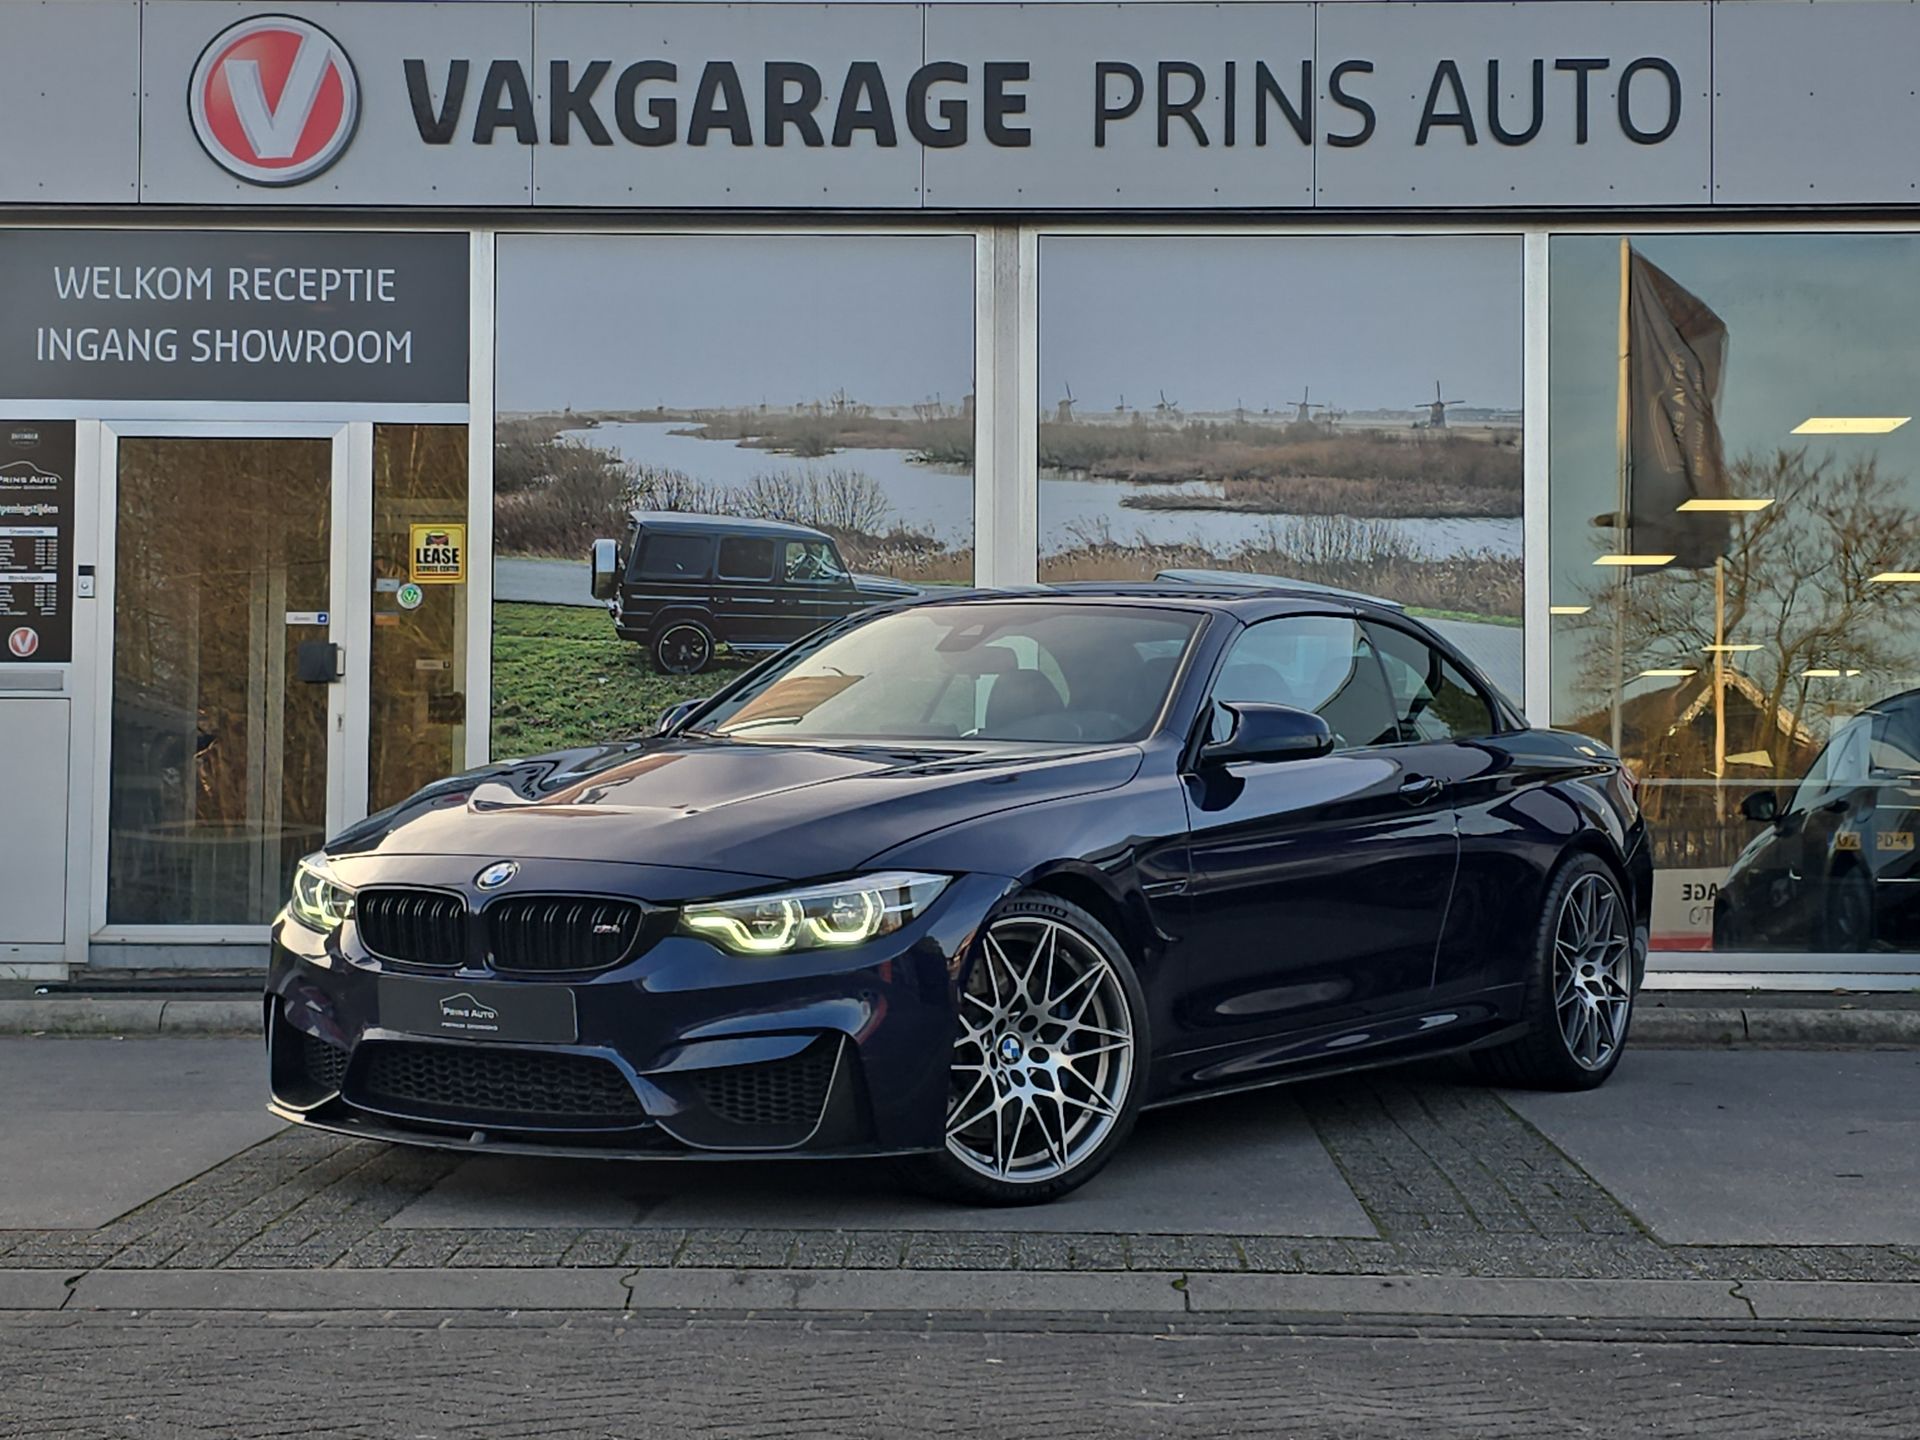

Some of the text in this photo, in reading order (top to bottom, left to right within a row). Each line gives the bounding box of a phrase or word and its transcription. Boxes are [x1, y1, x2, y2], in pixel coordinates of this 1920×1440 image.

[402, 56, 1682, 149] VAKGARAGE PRINS AUTO
[54, 266, 395, 302] WELKOM RECEPTIE
[37, 327, 411, 364] INGANG SHOWROOM
[415, 547, 460, 565] LEASE
